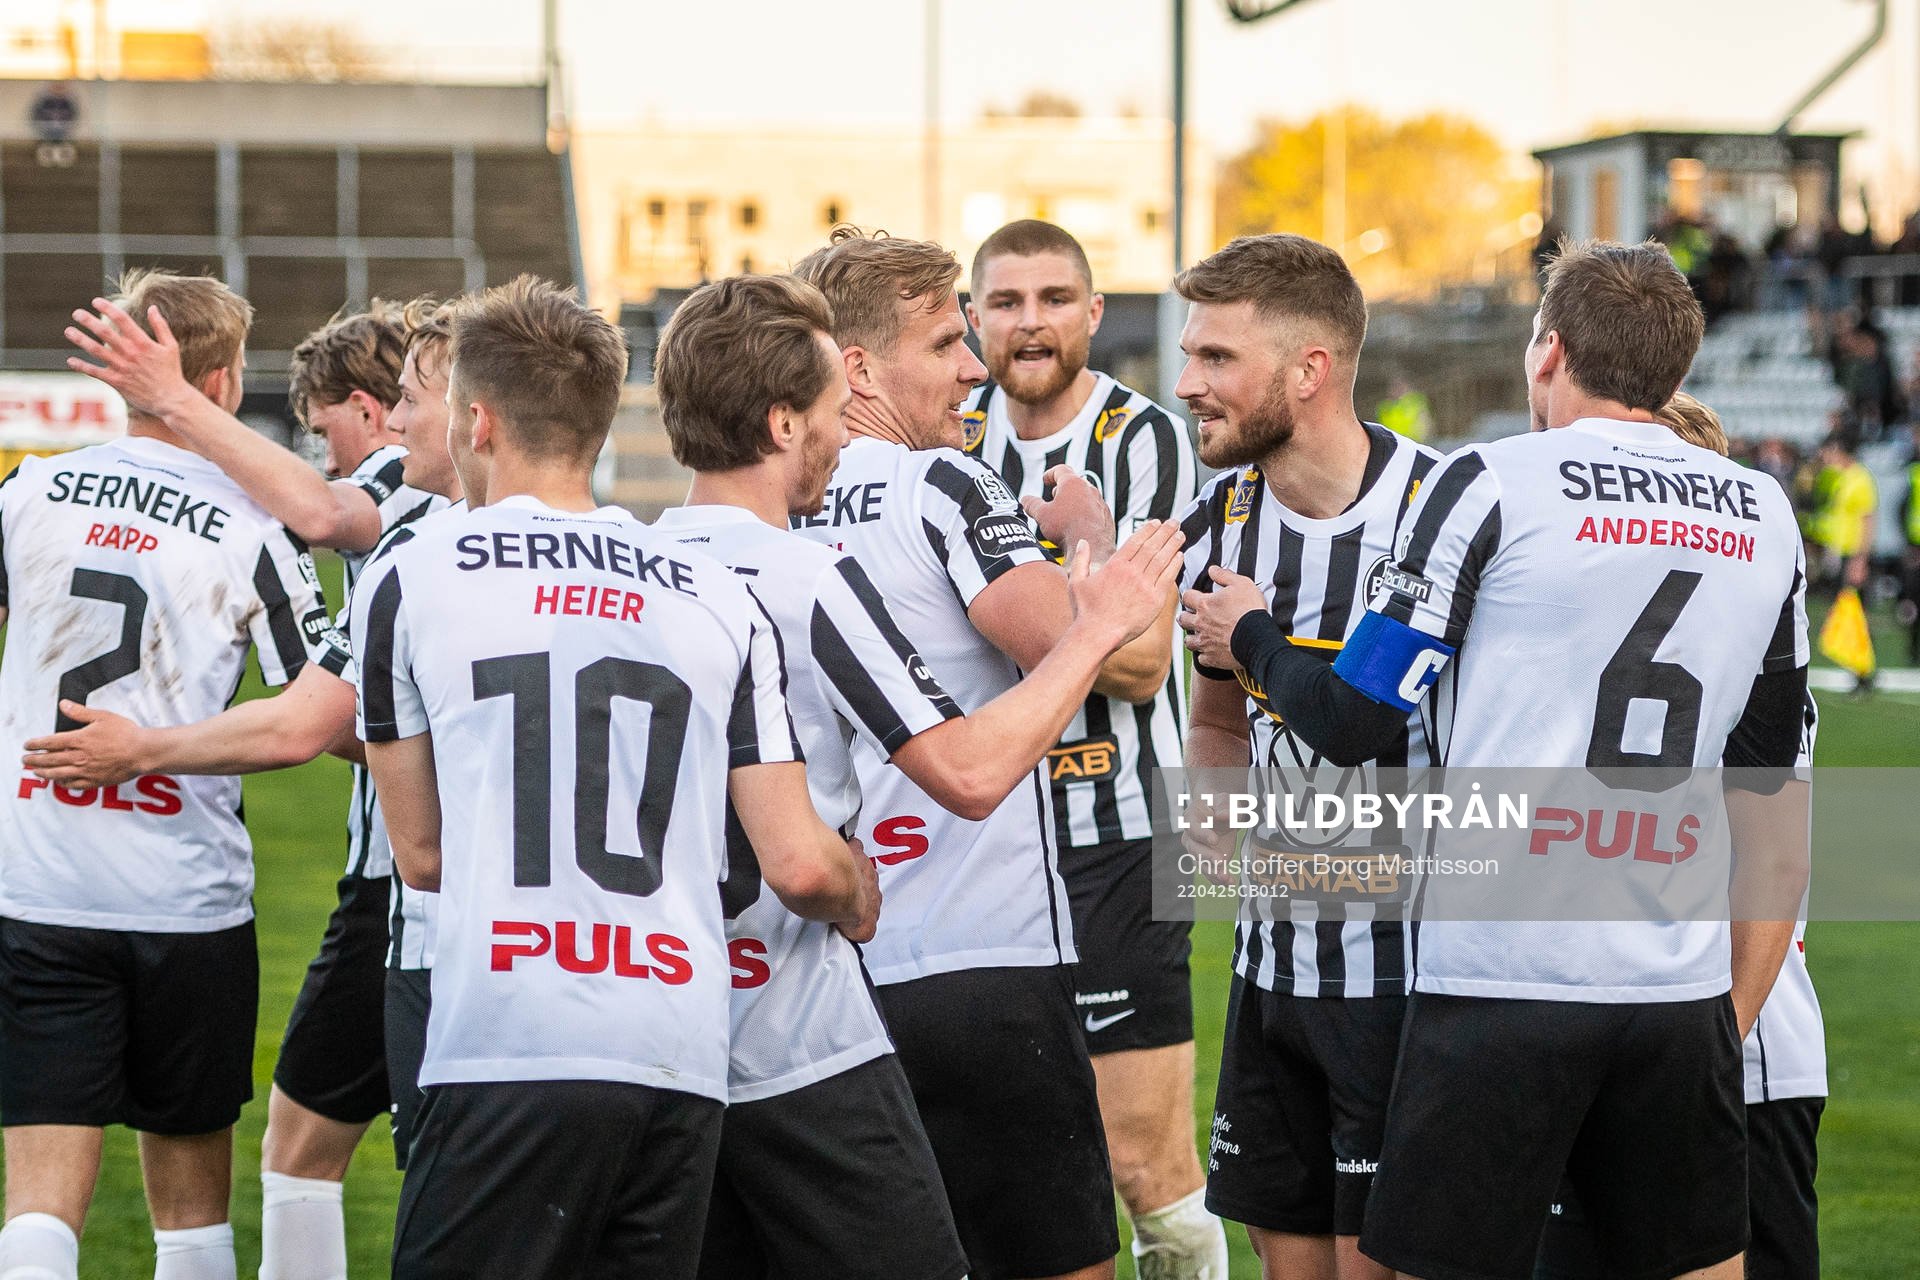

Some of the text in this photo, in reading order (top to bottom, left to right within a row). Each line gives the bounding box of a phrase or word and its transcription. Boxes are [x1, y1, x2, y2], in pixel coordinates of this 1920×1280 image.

[47, 471, 231, 543] SERNEKE
[1559, 460, 1760, 522] SERNEKE
[85, 523, 158, 554] RAPP
[456, 532, 698, 598] SERNEKE
[1576, 516, 1755, 562] ANDERSSON
[534, 585, 645, 624] HEIER
[55, 567, 148, 734] 2
[1398, 648, 1450, 704] C
[1585, 568, 1704, 793] 6
[471, 650, 693, 898] 10
[1529, 807, 1701, 865] PULS
[490, 920, 693, 986] PULS
